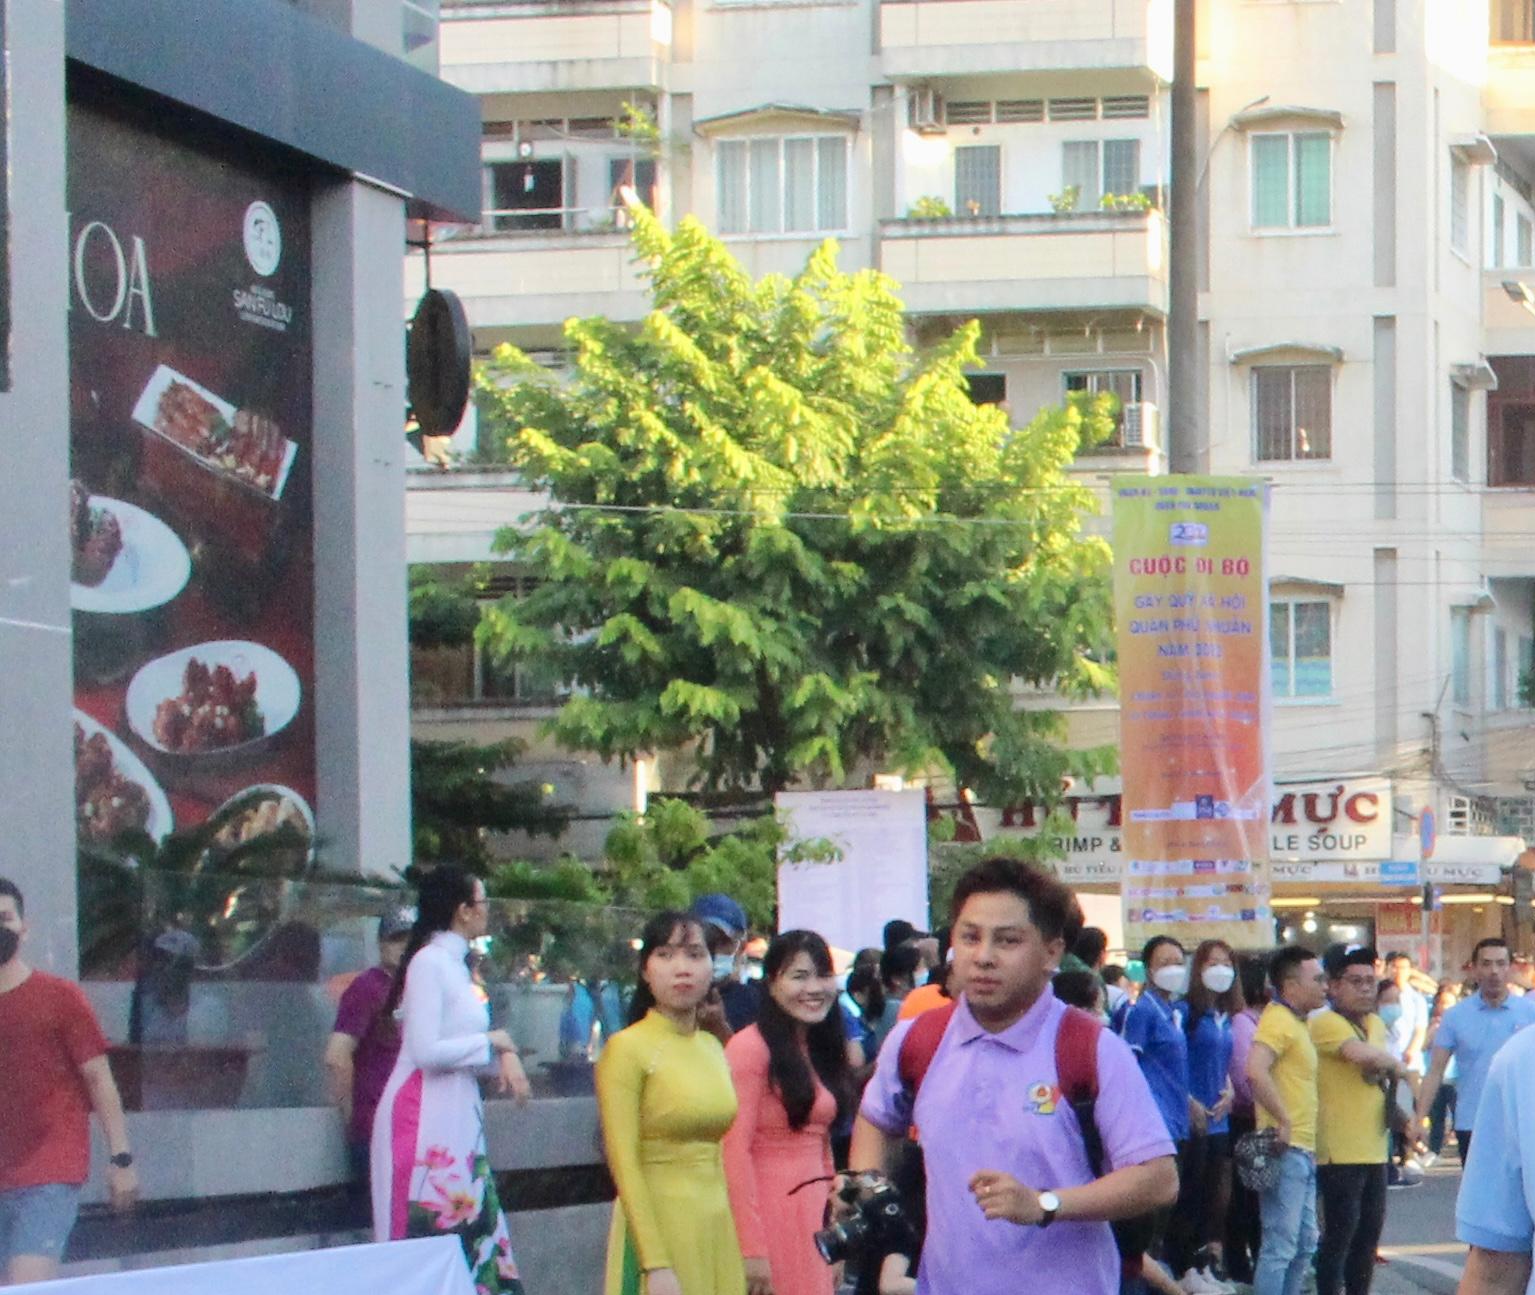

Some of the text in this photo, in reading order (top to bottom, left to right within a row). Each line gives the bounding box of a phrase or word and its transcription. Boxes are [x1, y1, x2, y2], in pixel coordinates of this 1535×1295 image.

[74, 220, 157, 337] OA
[1130, 555, 1186, 578] CUỘC
[1308, 834, 1367, 851] SOUP
